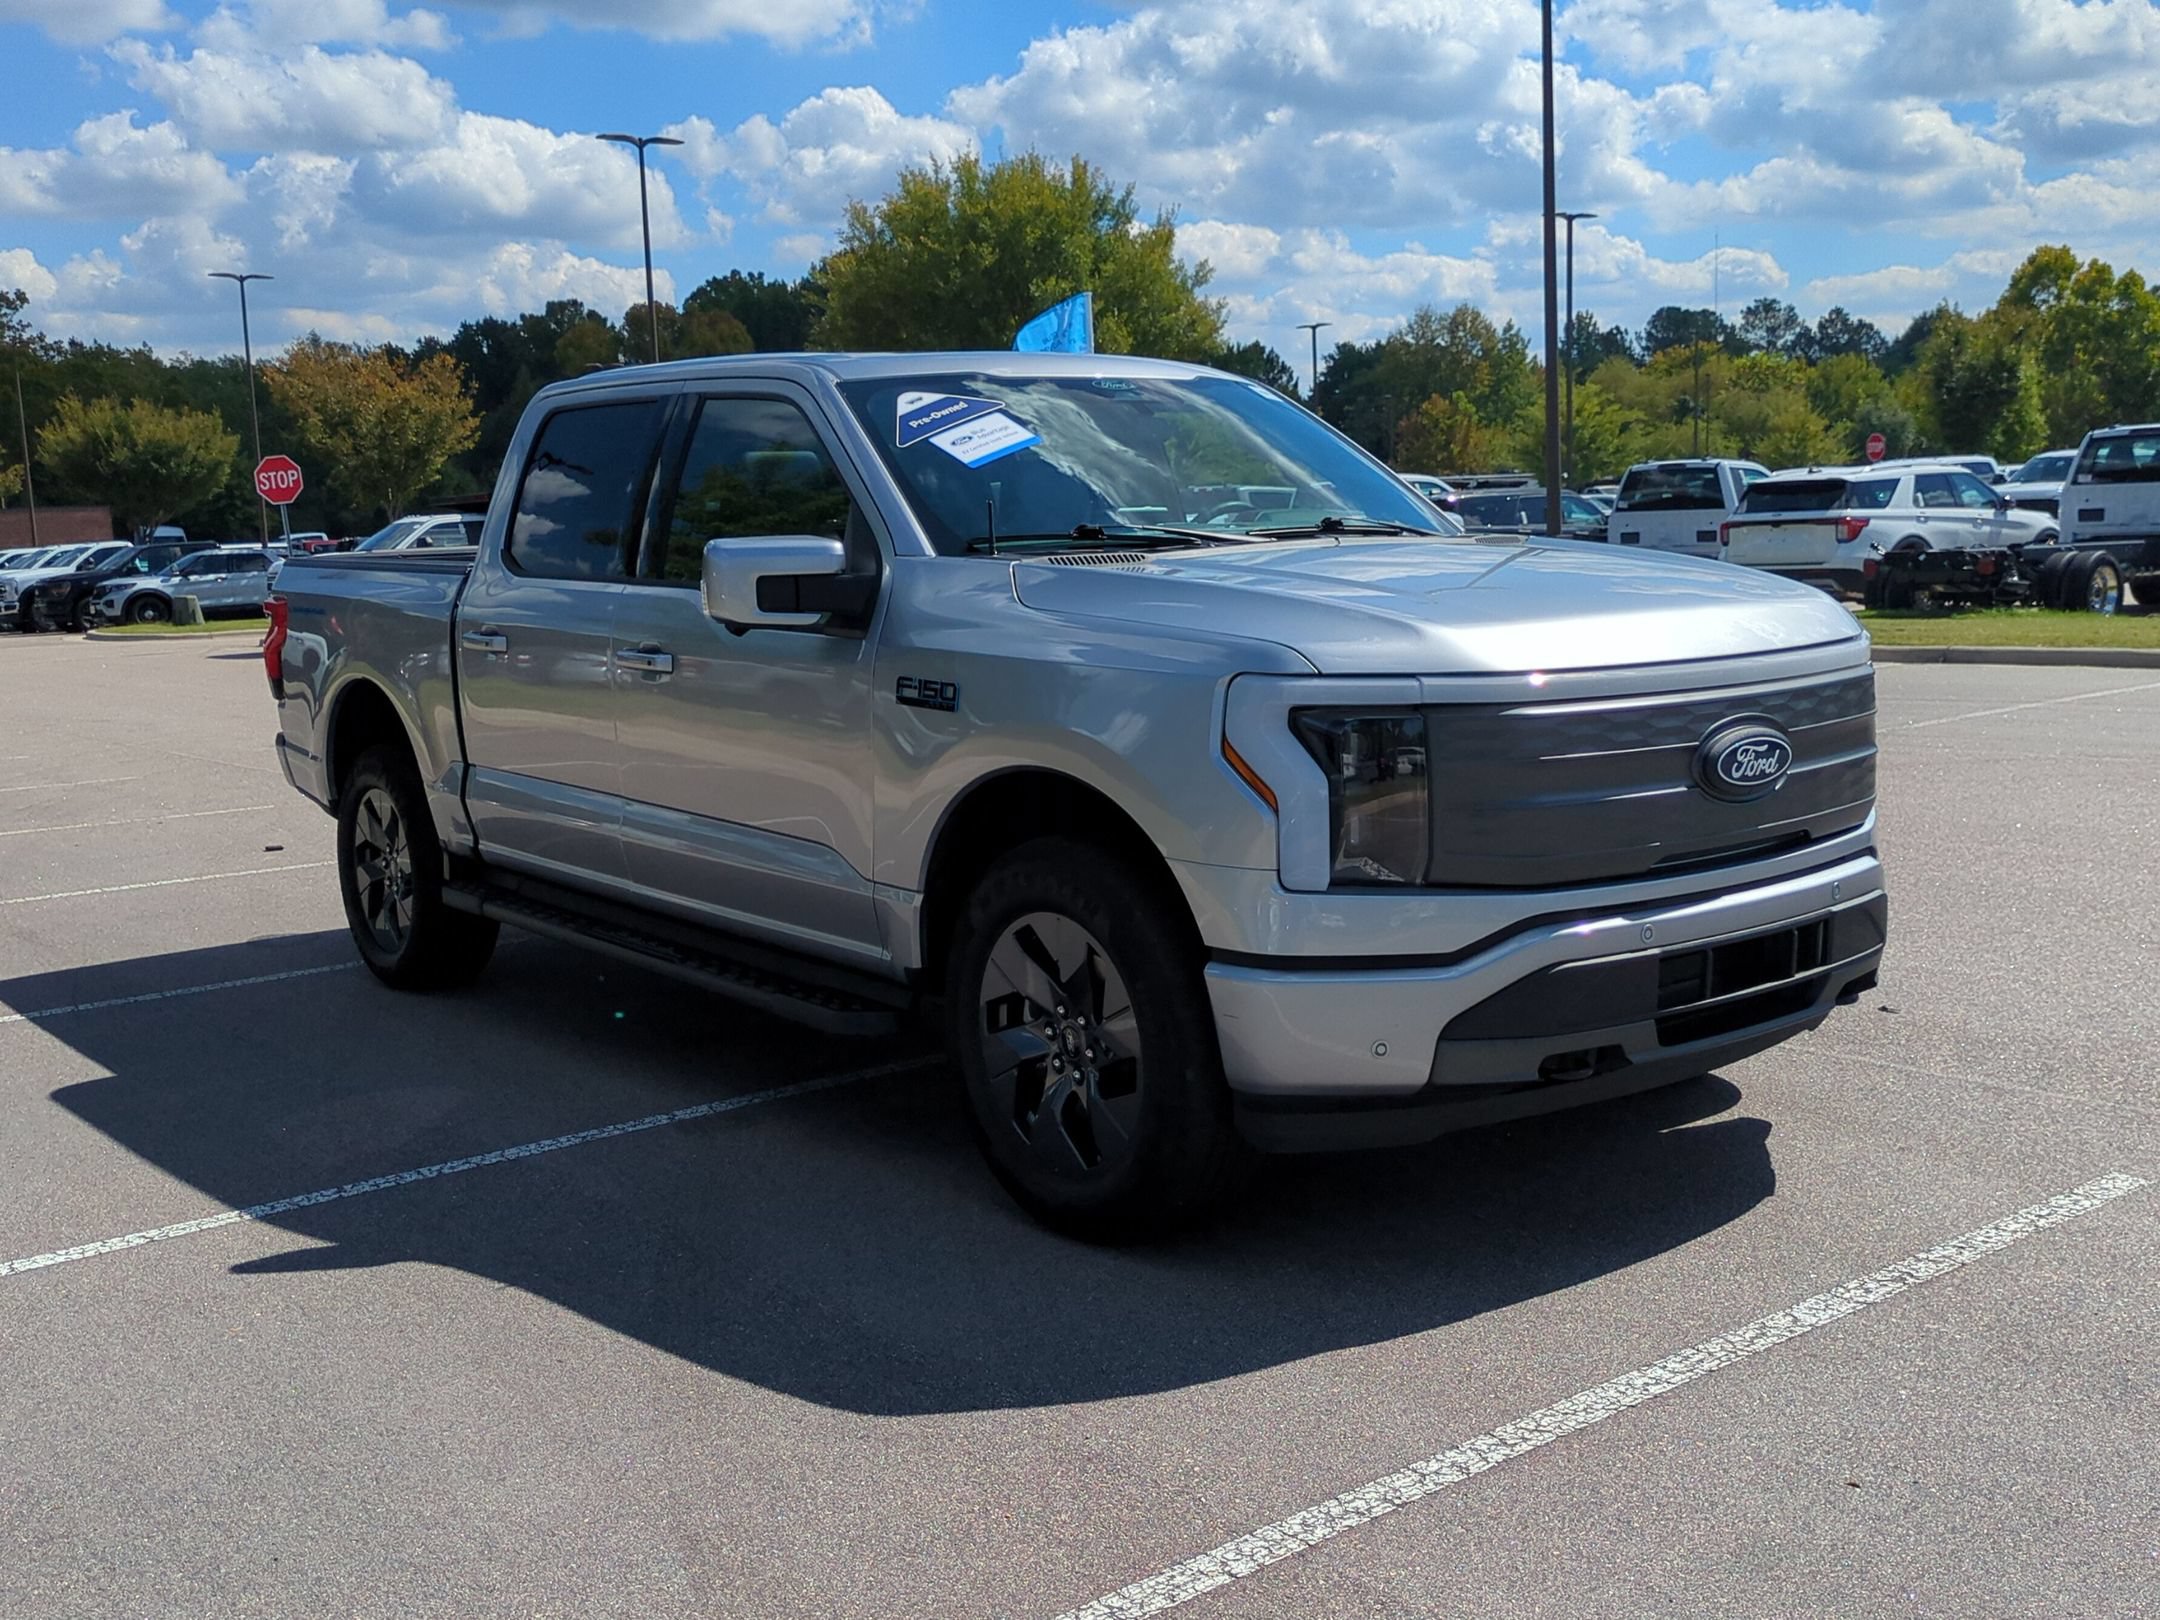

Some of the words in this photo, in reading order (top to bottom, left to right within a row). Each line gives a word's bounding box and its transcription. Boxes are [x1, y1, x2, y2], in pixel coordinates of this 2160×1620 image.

[908, 400, 969, 429] Pre-Owned
[259, 469, 299, 490] STOP
[1731, 743, 1781, 779] Ford
